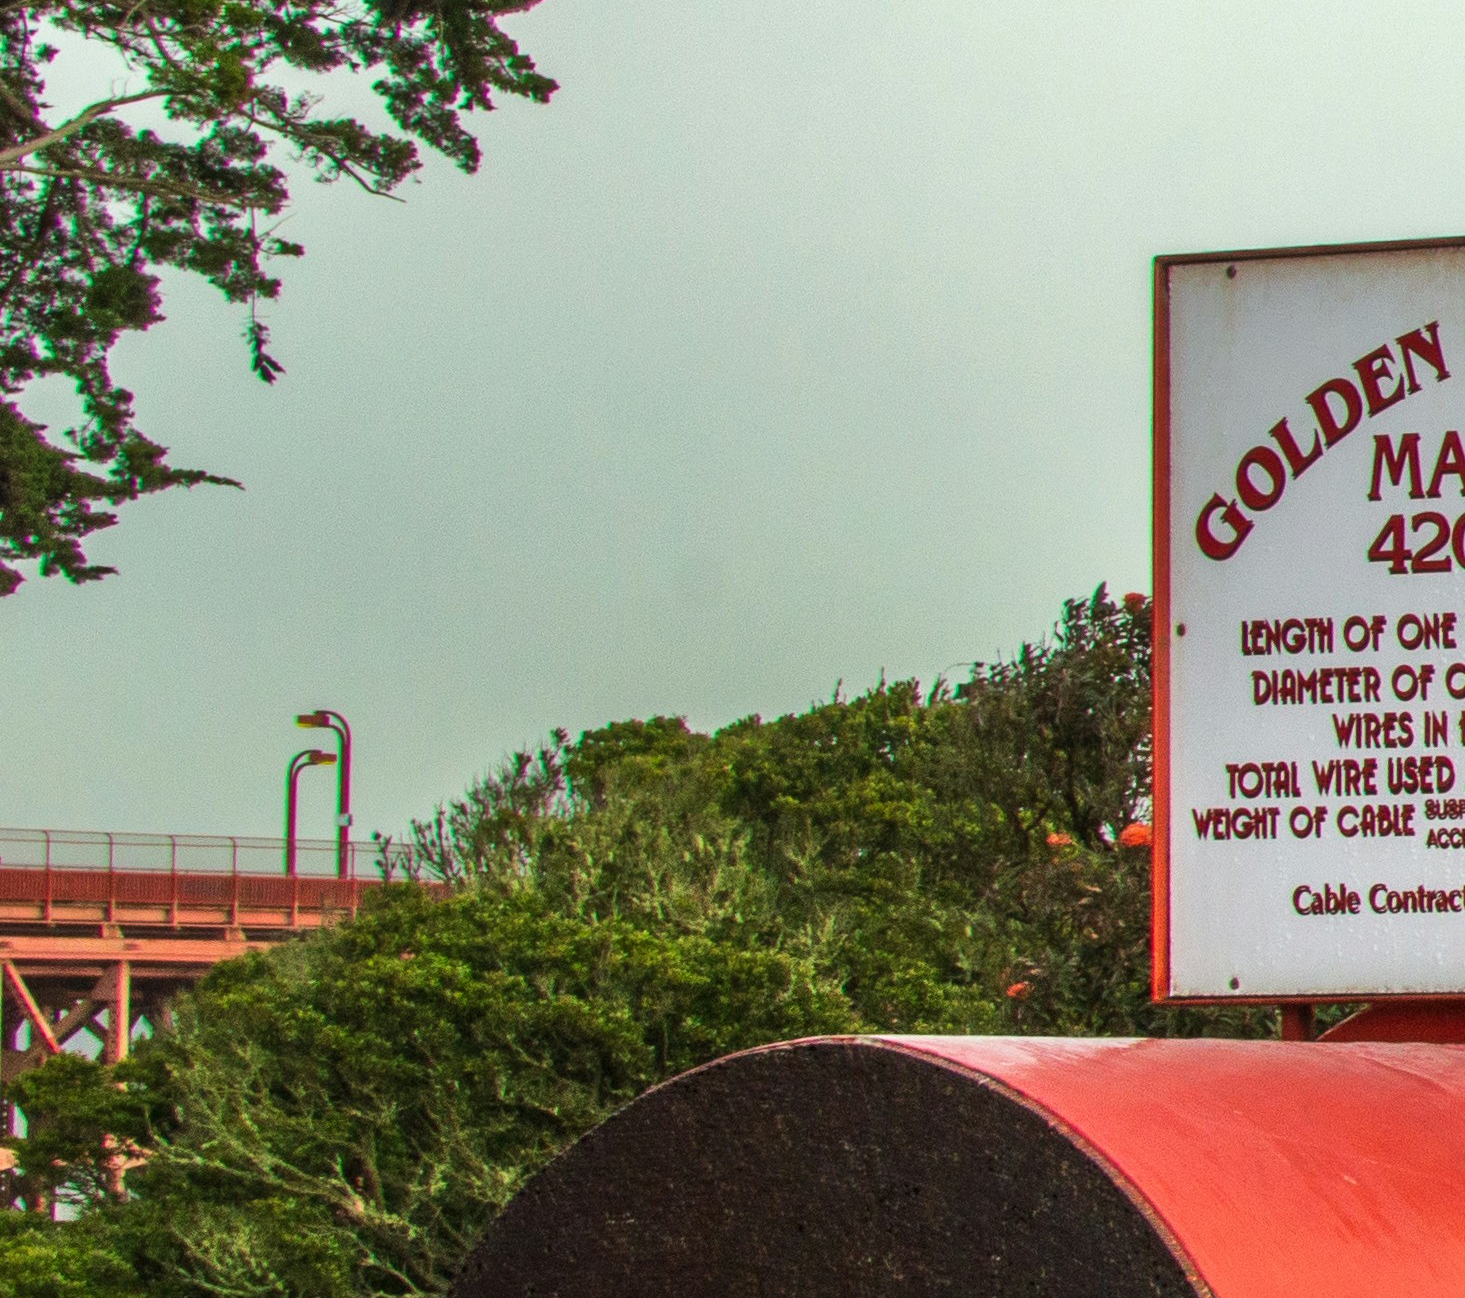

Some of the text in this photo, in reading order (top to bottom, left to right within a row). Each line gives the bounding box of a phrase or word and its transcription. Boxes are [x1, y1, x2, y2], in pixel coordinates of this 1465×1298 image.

[1193, 320, 1452, 562] GOLDEN
[1240, 617, 1335, 657] LENGTH
[1342, 615, 1388, 653] OF
[1396, 612, 1458, 651] ONE
[1250, 666, 1382, 706] DIAMETER
[1390, 664, 1436, 702] OF
[1331, 711, 1415, 749] WIRES
[1423, 710, 1448, 748] IN
[1224, 761, 1302, 800] TOTAL
[1311, 757, 1378, 797] WIRE
[1386, 755, 1456, 795] USED
[1191, 803, 1416, 841] WEIGHT OF CABLE
[1291, 883, 1362, 916] Cable
